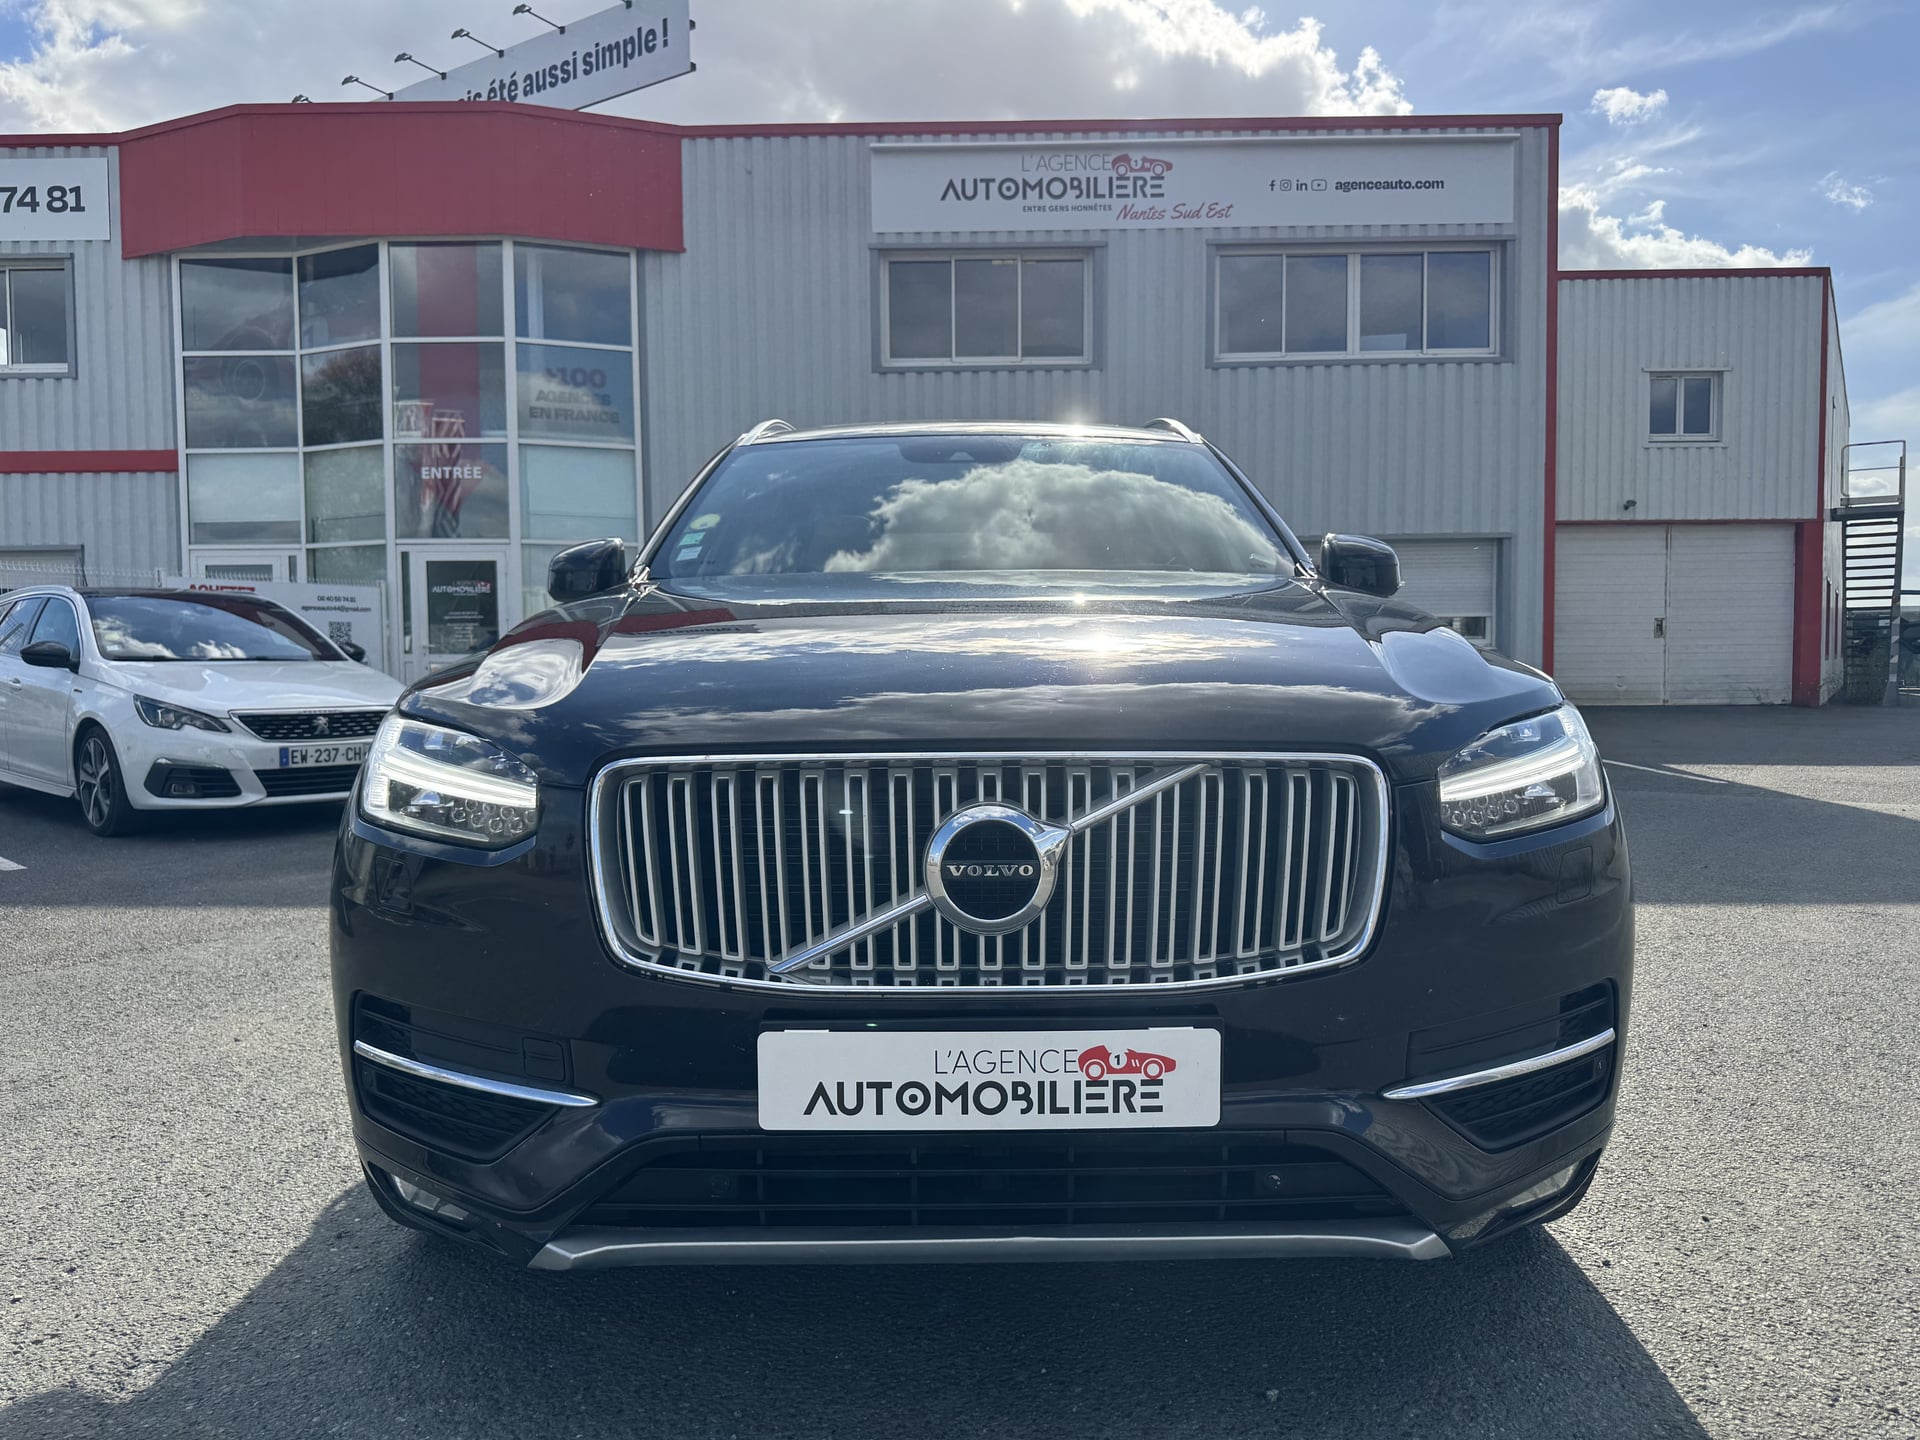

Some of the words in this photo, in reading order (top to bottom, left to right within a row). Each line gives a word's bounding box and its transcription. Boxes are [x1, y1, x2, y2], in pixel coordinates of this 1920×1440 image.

[523, 51, 578, 98] aussi
[582, 26, 658, 76] simple
[1021, 153, 1112, 172] L'AGENCE
[1335, 179, 1445, 193] agenceauto.com
[0, 186, 40, 213] 74
[46, 185, 86, 213] 81
[1022, 205, 1047, 213] ENTRE
[1048, 204, 1070, 212] GENS
[1071, 203, 1112, 212] HONNÊTES
[1115, 203, 1166, 222] Nantes
[1170, 201, 1203, 220] Sud
[1205, 202, 1235, 219] Est
[529, 406, 551, 419] EN
[554, 407, 620, 424] FRANCE
[421, 463, 482, 479] ENTRÉE
[947, 865, 1034, 876] VOLVO
[934, 1049, 1078, 1074] L'AGENCE
